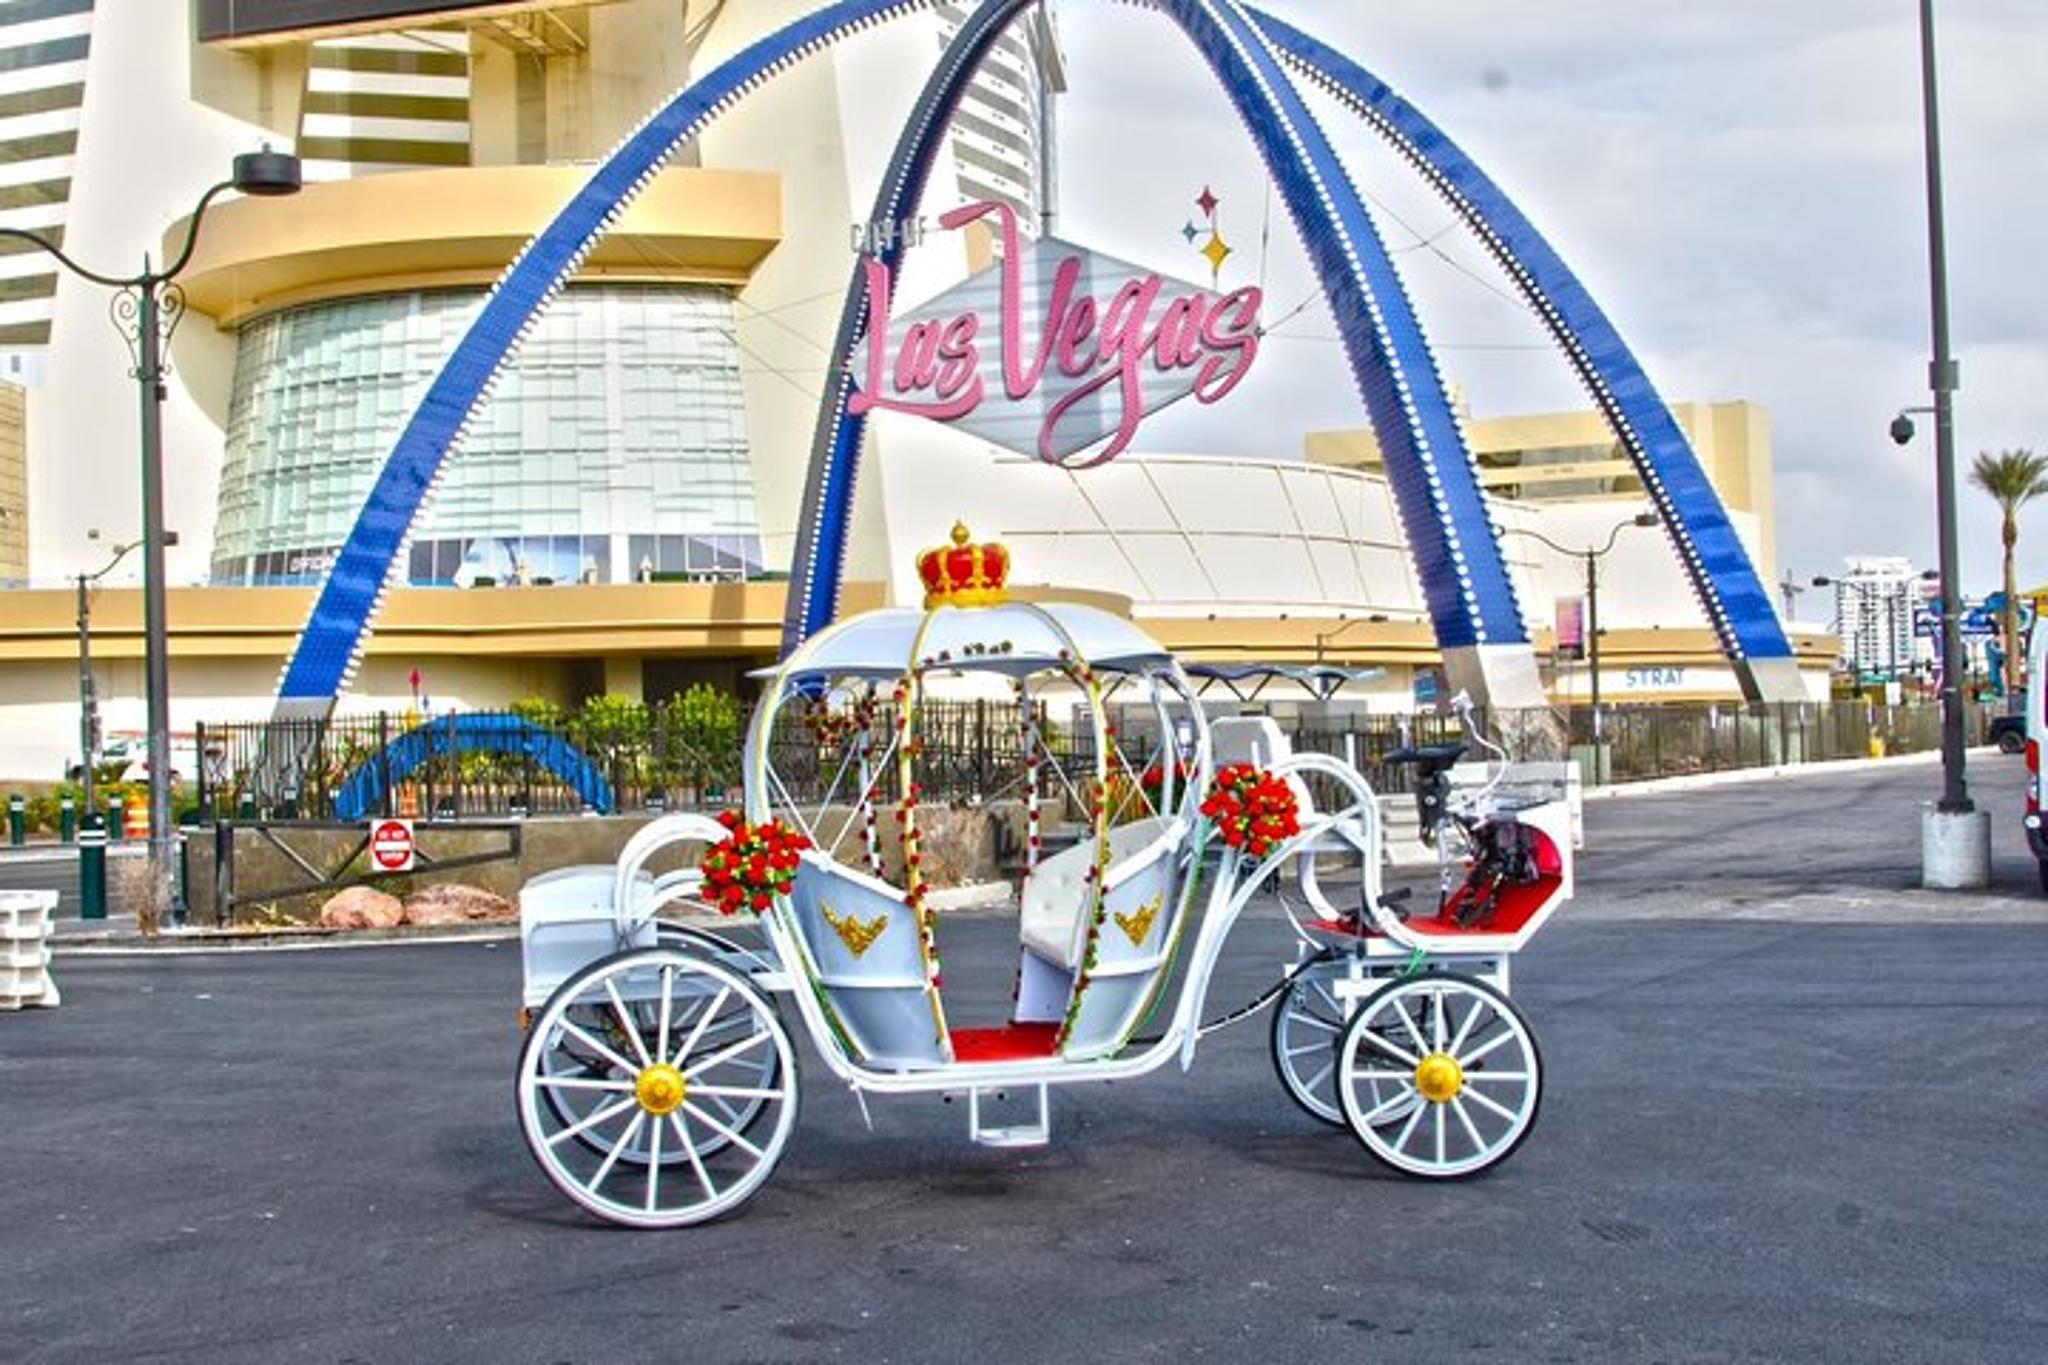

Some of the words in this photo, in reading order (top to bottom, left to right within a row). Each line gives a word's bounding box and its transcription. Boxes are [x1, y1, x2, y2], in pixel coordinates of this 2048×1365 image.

[848, 256, 984, 421] Las
[939, 200, 1263, 469] Vegas
[1626, 667, 1684, 688] STRAT
